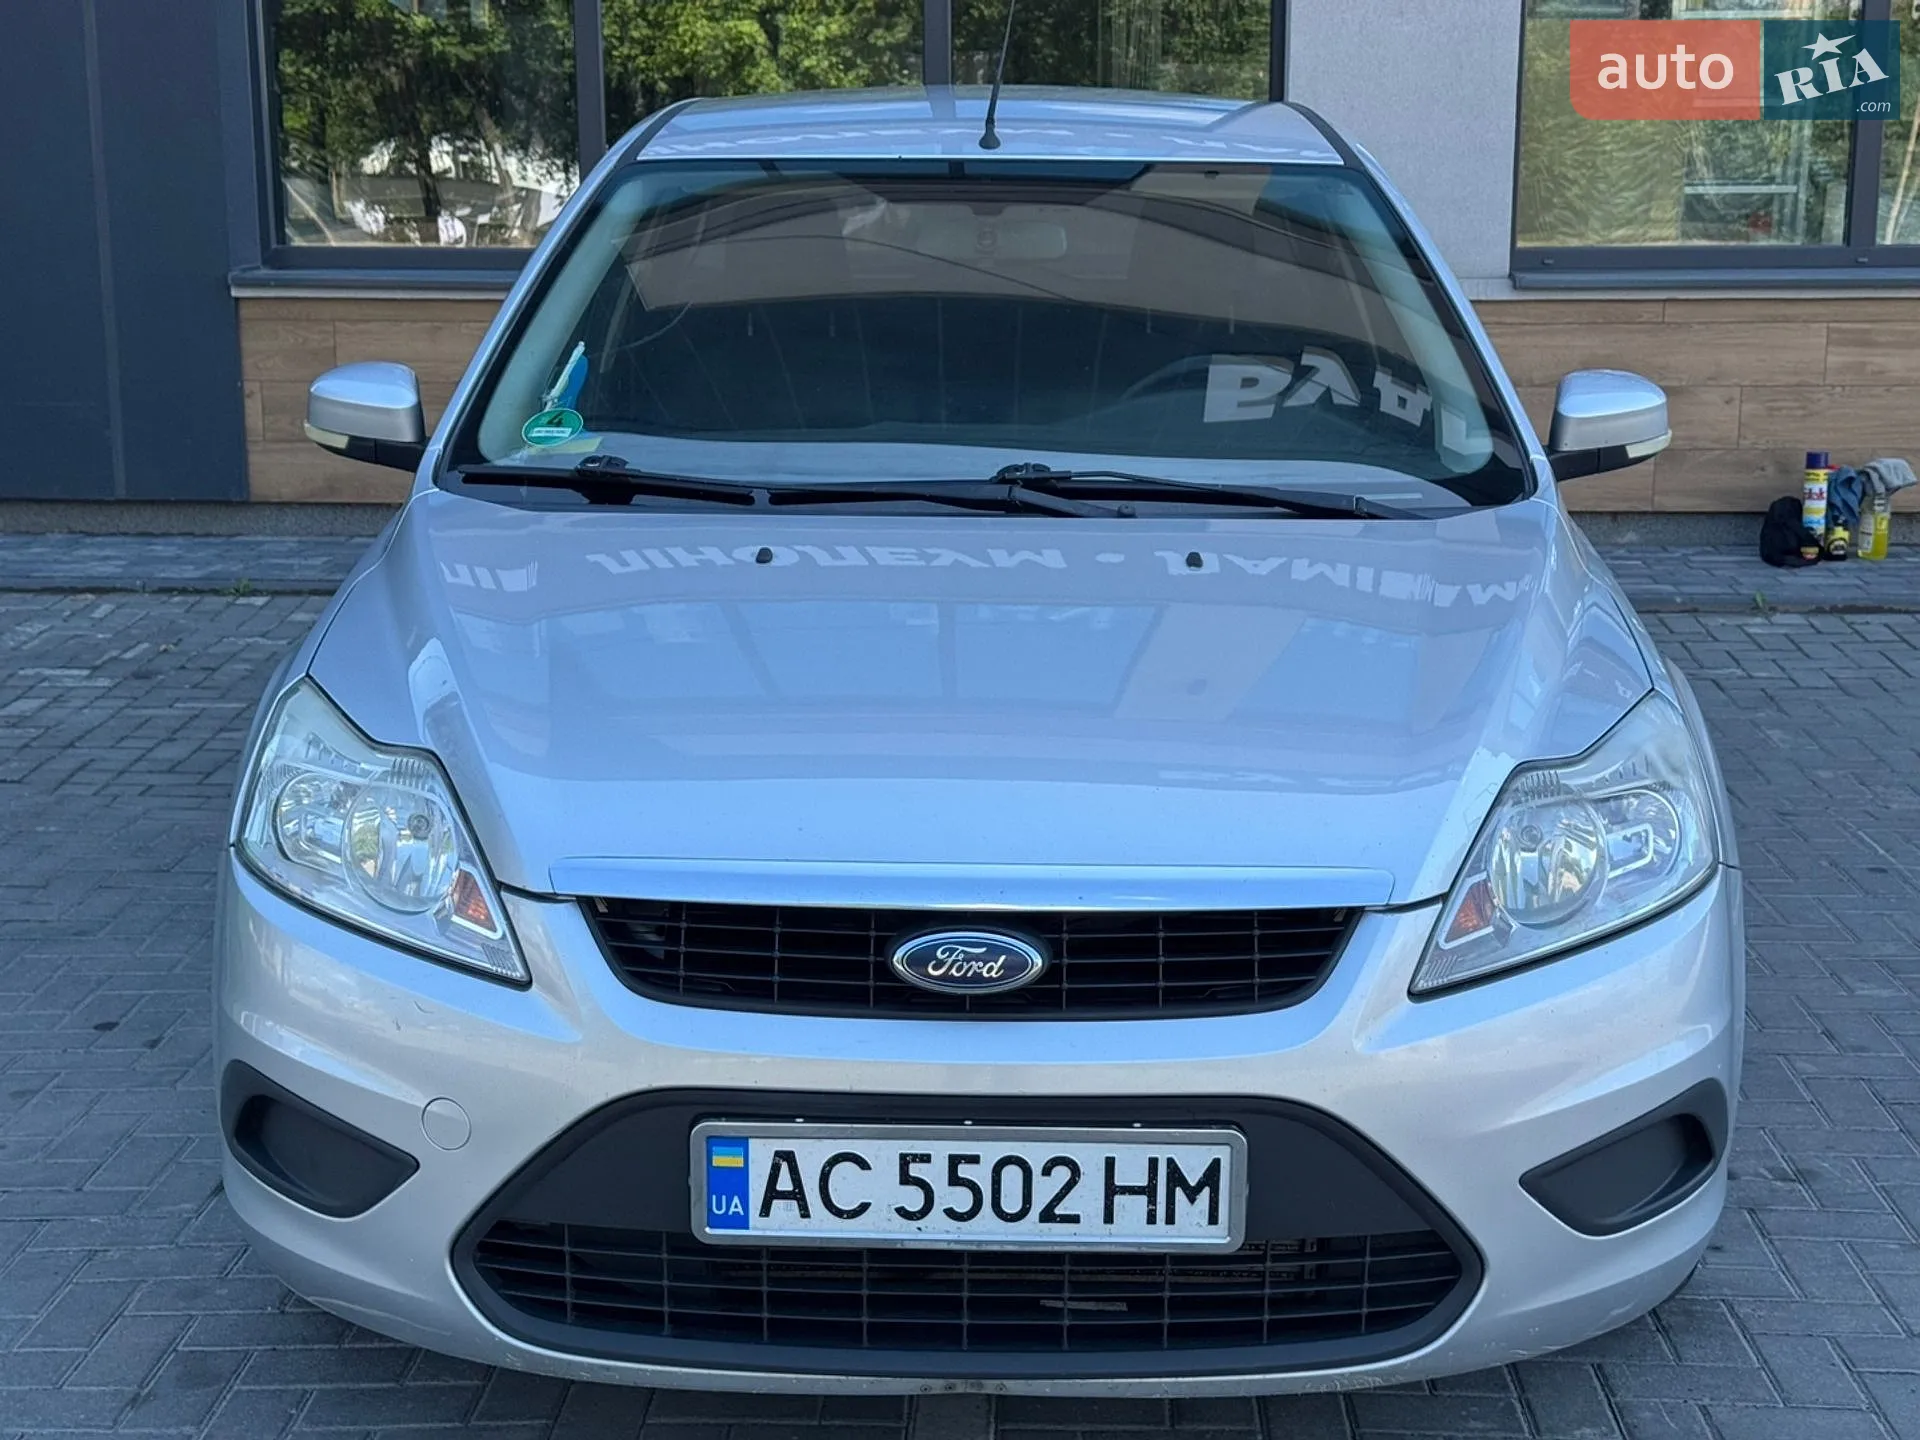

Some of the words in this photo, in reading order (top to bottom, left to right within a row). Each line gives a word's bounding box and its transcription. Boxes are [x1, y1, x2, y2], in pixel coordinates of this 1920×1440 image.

[927, 944, 1006, 978] Ford
[758, 1149, 873, 1220] AC
[893, 1152, 1081, 1225] 5502
[1102, 1155, 1222, 1226] HM
[711, 1195, 744, 1216] UA
